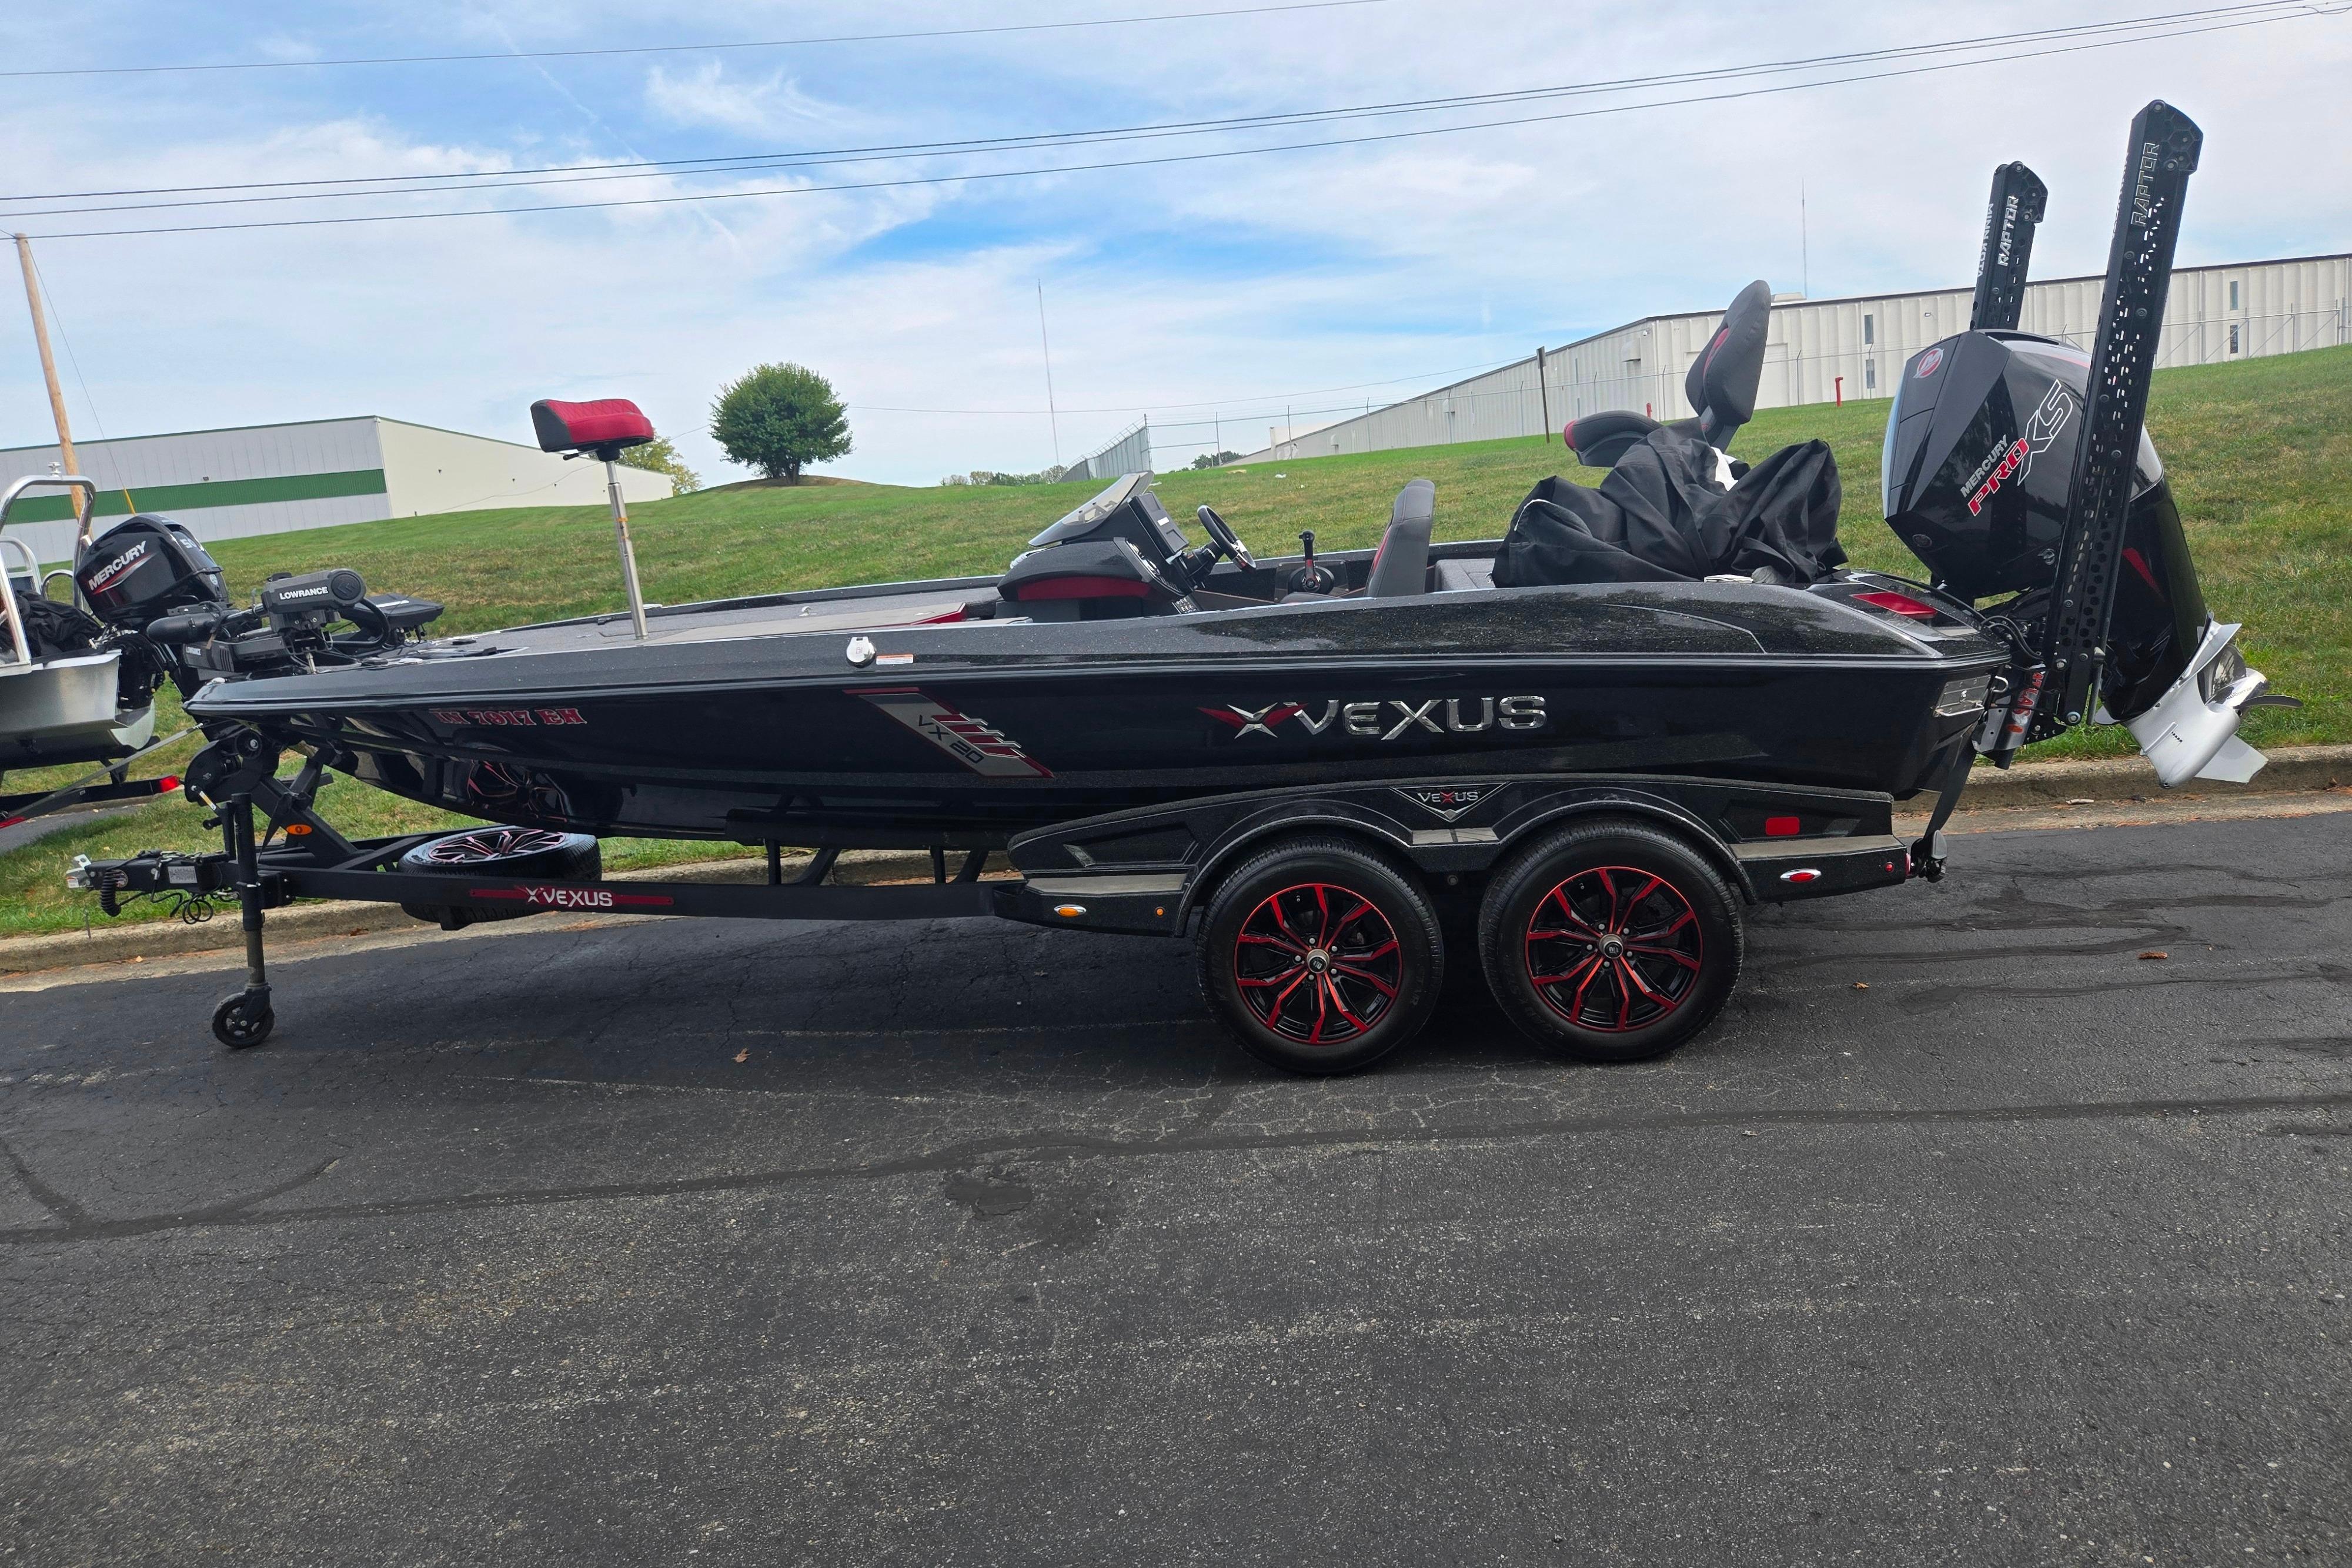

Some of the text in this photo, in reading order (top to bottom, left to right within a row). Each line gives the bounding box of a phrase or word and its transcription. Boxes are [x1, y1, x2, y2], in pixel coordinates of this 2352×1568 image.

[2131, 142, 2160, 228] RAPTOR
[1977, 203, 1993, 278] MINN KOTA
[1998, 196, 2019, 266] RAPTOR
[1960, 434, 2008, 497] MERCURY
[1967, 379, 2073, 516] PRO XS
[88, 540, 146, 590] MERCURY
[279, 587, 328, 600] LOWRANCE
[468, 710, 536, 726] 7917
[1418, 791, 1479, 804] VEXUS
